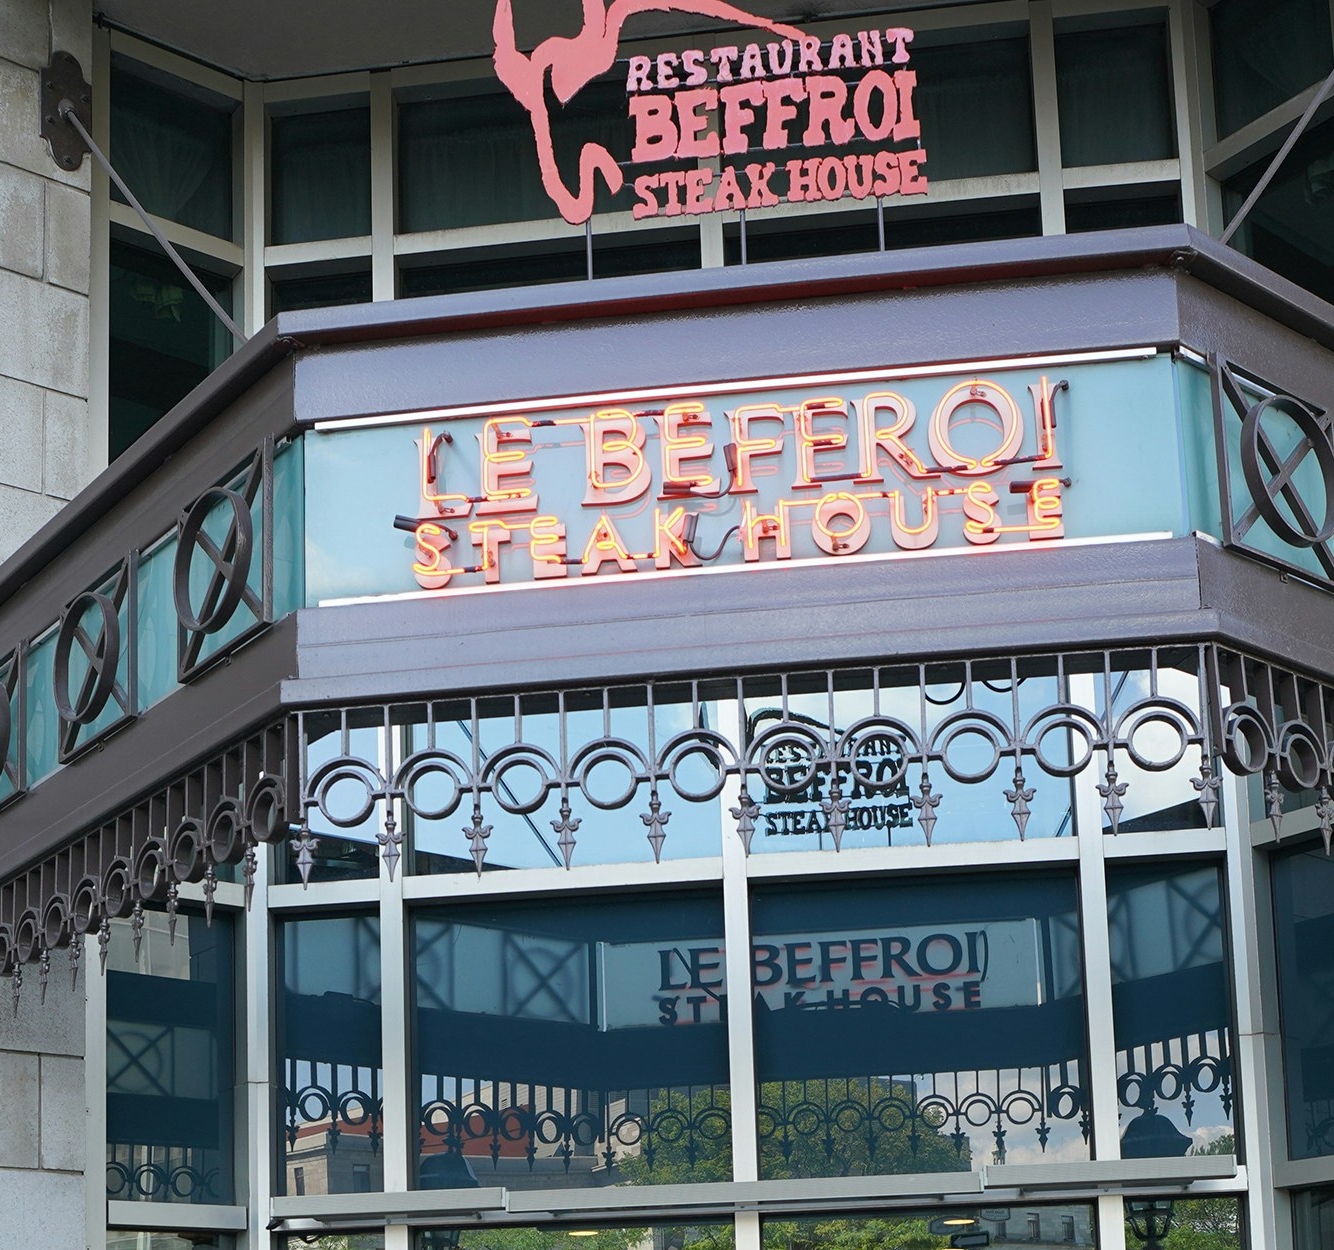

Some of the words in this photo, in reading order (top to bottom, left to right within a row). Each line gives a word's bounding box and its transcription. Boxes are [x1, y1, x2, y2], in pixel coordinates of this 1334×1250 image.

[626, 28, 915, 92] RESTAURANT
[628, 70, 923, 164] BEFFROI
[633, 160, 781, 220] STEAK
[786, 149, 928, 203] HOUSE
[413, 415, 539, 518] LE
[580, 376, 1063, 507] BEFFROI
[411, 507, 703, 590] STEAK
[739, 478, 1065, 563] HOUSE
[844, 802, 915, 831] HOUSE
[657, 946, 724, 991] LE
[751, 931, 981, 987] BEFFROI
